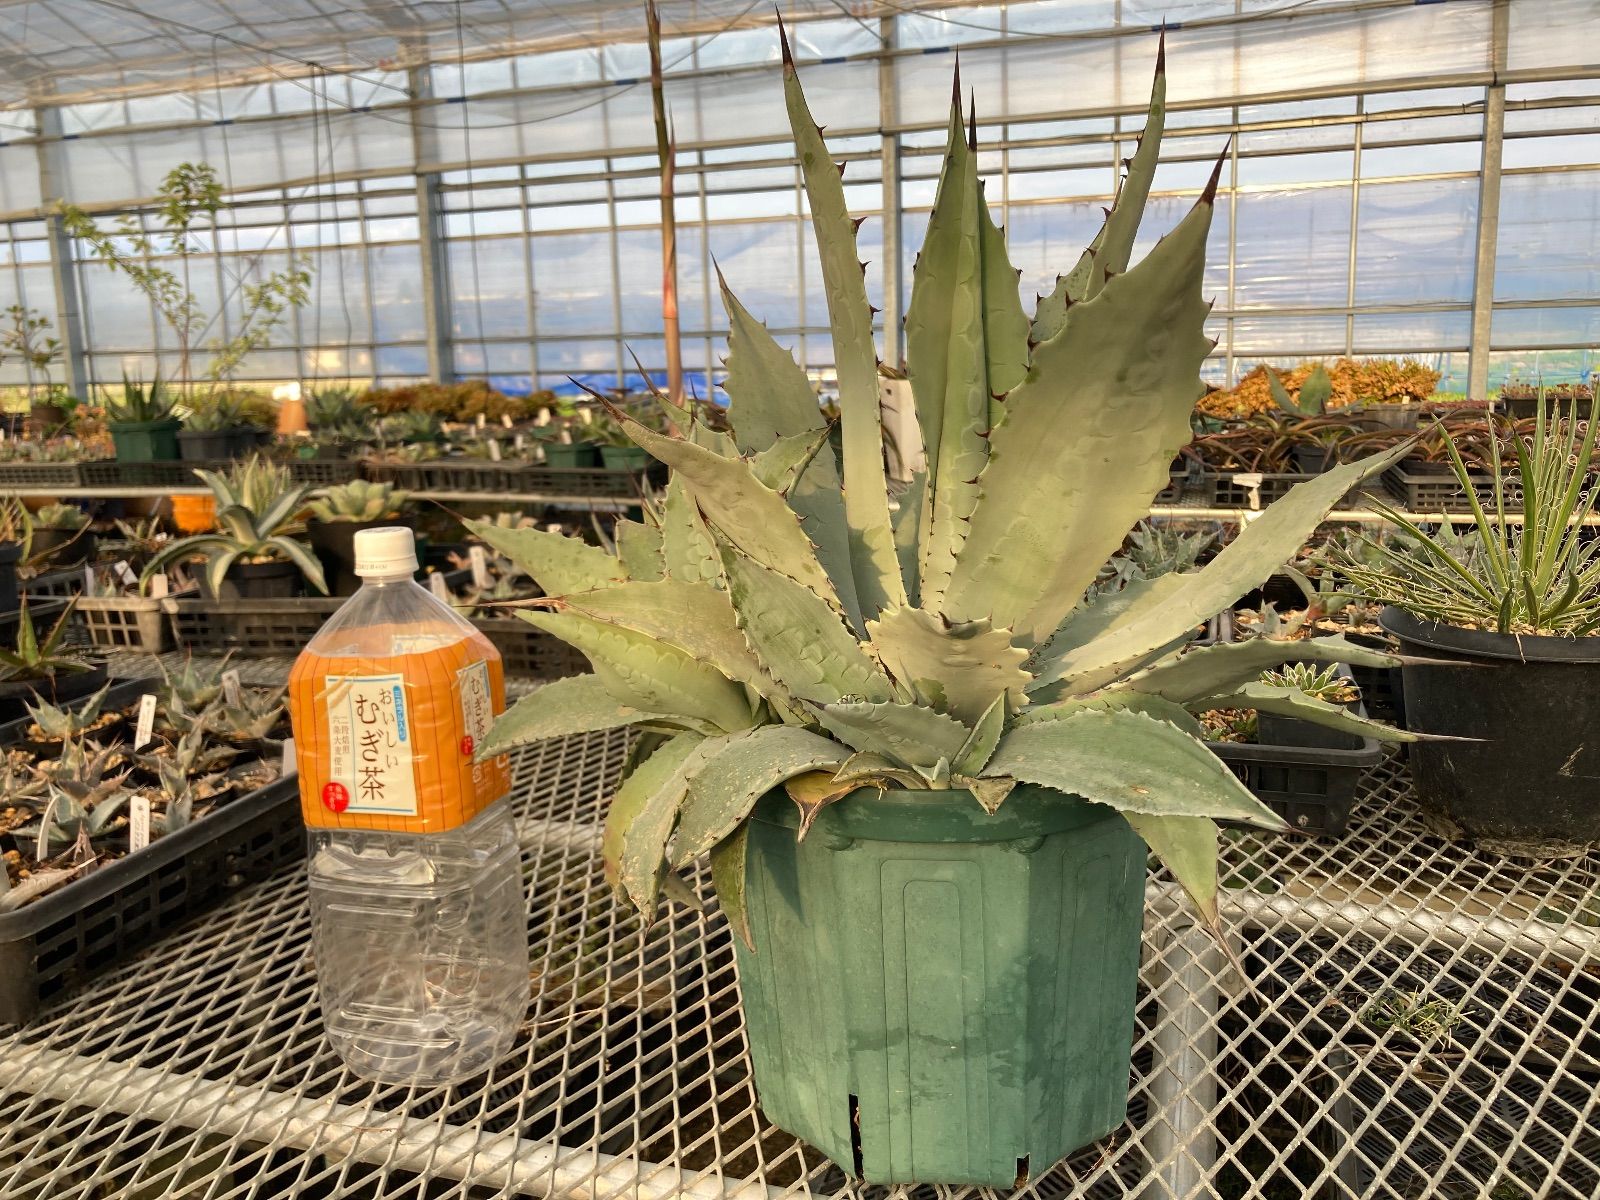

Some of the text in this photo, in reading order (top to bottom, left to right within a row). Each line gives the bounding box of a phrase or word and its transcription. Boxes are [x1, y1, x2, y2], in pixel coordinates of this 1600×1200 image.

[355, 694, 386, 800] むぎ茶
[379, 688, 399, 768] おいしい
